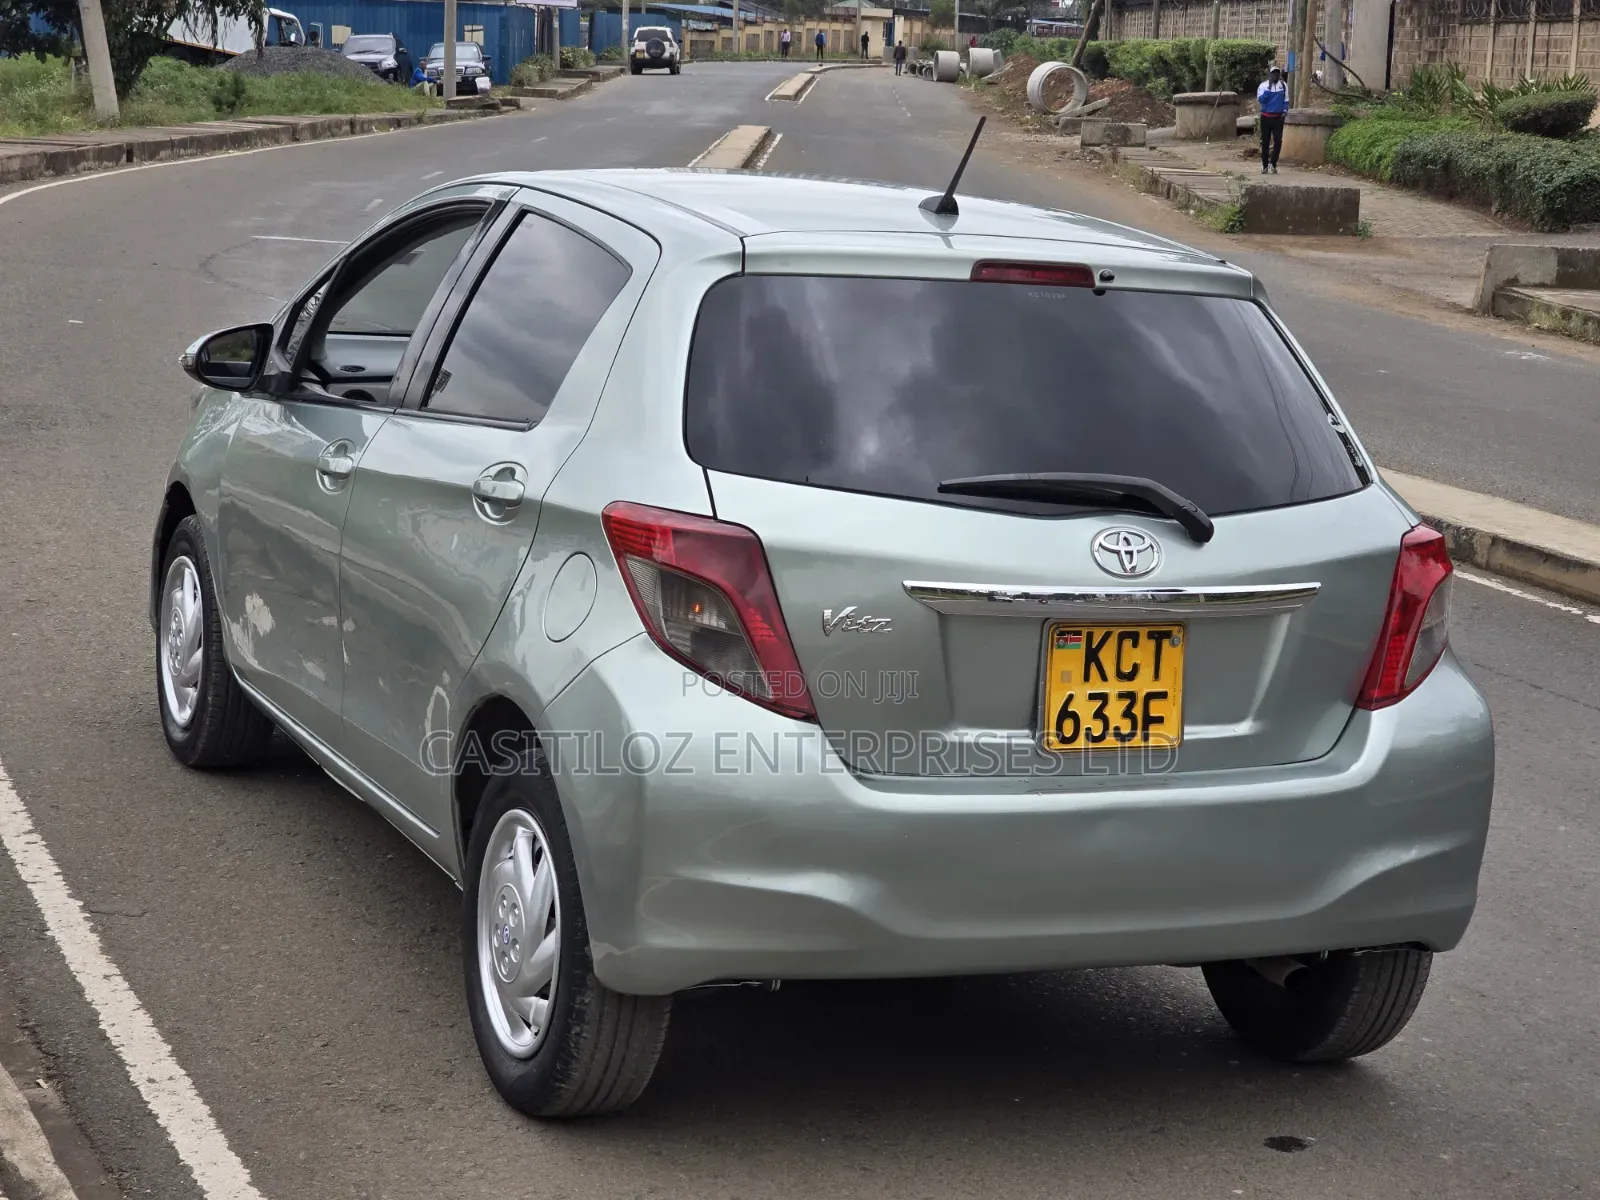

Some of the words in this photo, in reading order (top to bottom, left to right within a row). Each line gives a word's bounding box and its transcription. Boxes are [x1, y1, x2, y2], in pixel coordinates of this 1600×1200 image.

[822, 606, 893, 637] Vitz
[1083, 630, 1173, 683] KCT
[1055, 690, 1169, 745] 633F
